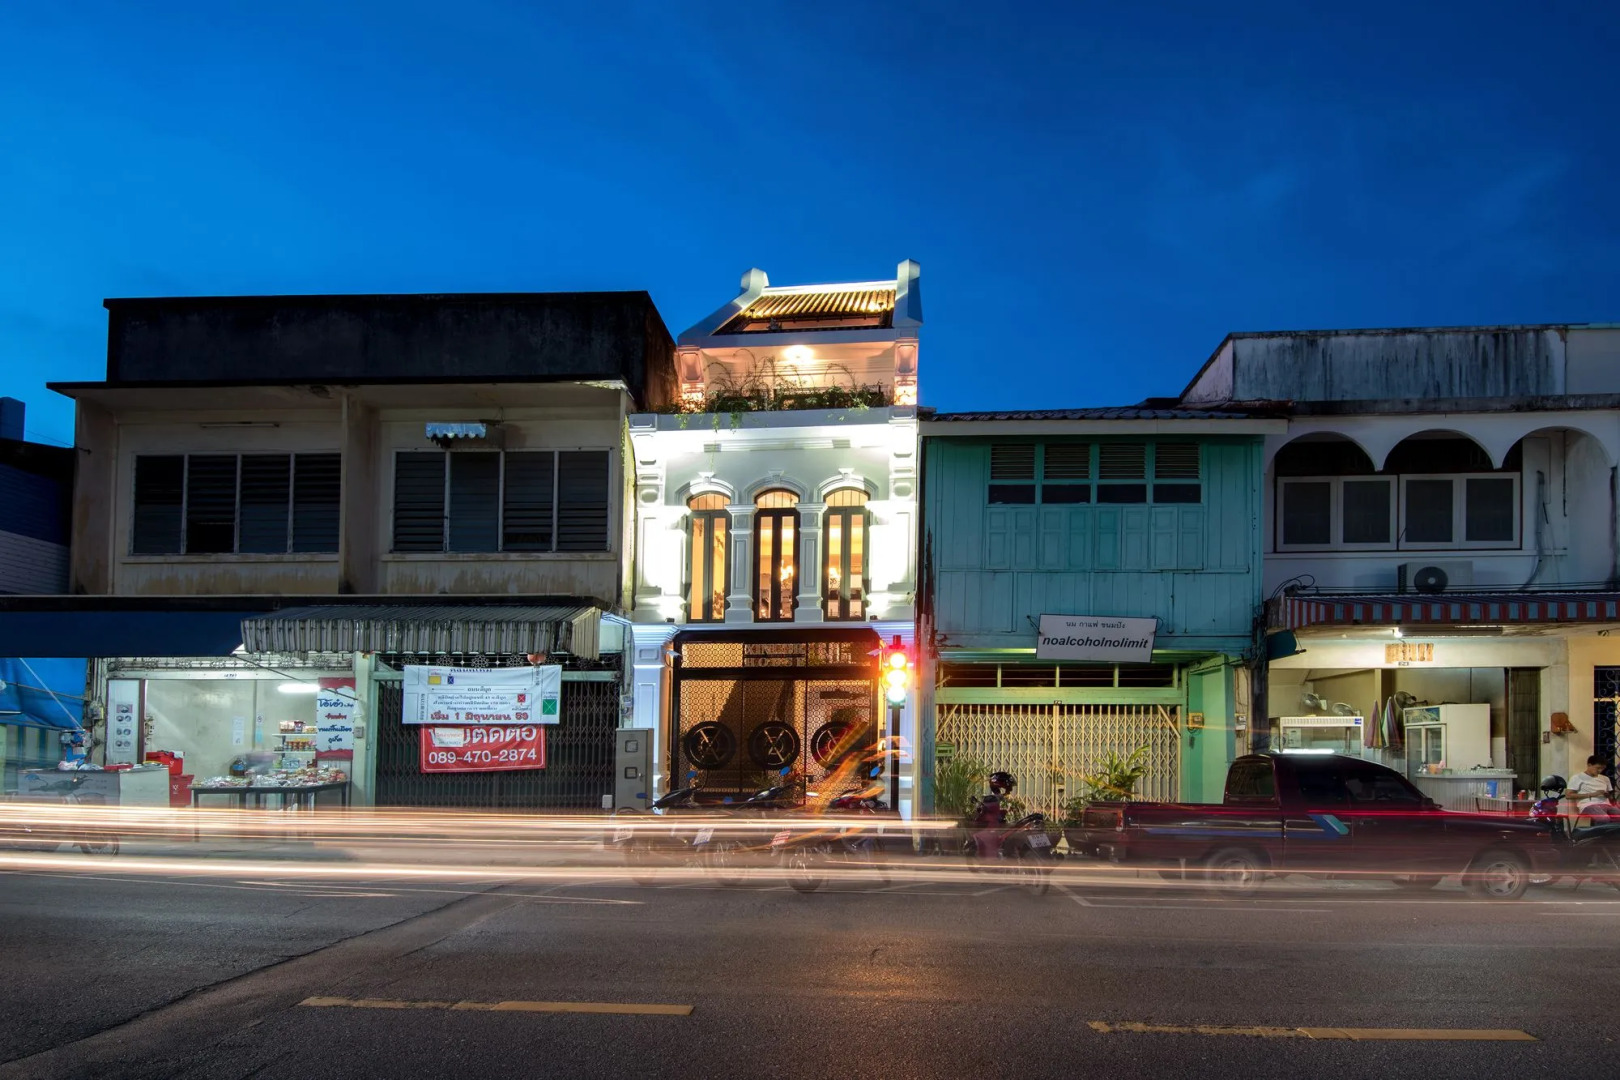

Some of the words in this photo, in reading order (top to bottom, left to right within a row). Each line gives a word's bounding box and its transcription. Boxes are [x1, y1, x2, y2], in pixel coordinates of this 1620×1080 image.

[1079, 620, 1098, 628] กาแฟ
[1101, 621, 1126, 629] ขนมปัง
[1042, 636, 1148, 648] noalcoholnolimit
[430, 710, 449, 721] เริ่ม
[455, 712, 460, 720] 1
[465, 711, 511, 723] มิถุนายน
[515, 711, 529, 721] 59
[428, 748, 537, 764] 089-470-2874
